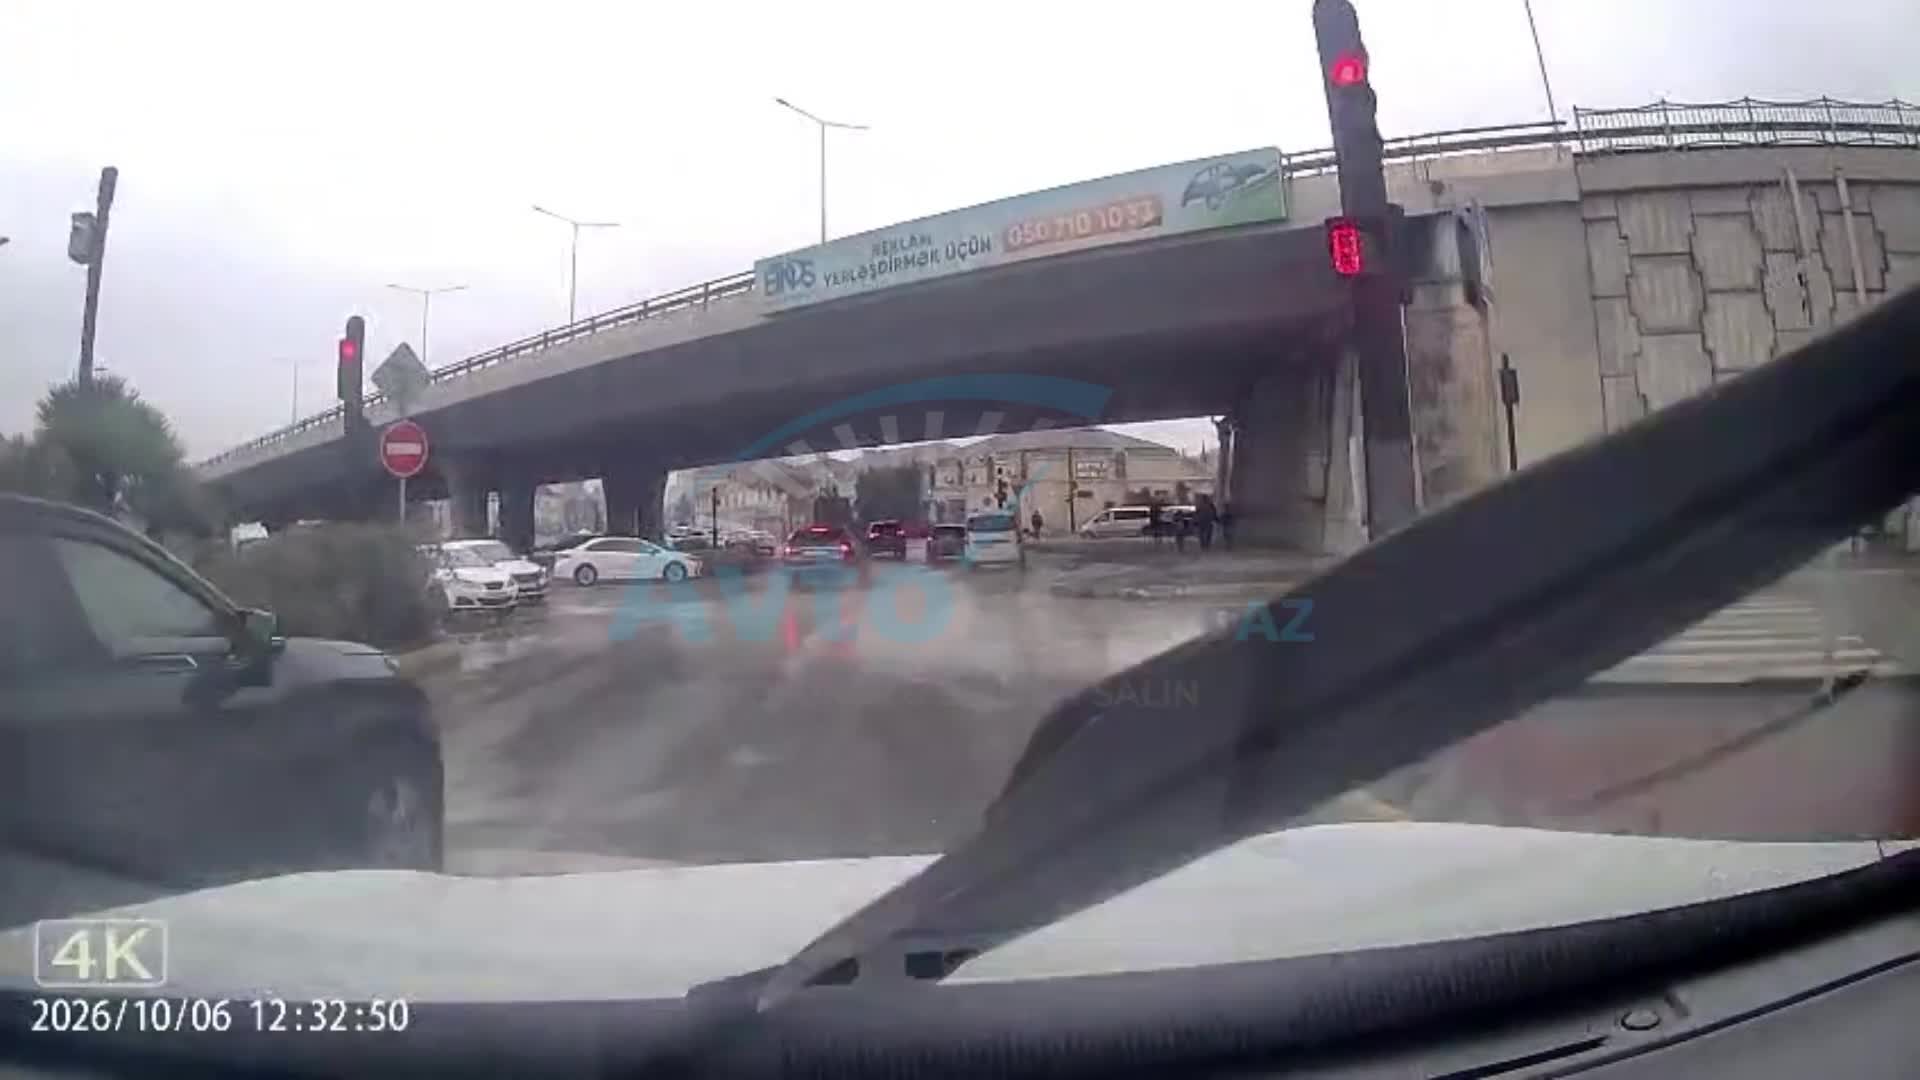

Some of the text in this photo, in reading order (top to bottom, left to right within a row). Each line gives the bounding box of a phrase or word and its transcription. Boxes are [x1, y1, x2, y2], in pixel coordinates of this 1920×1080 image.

[1008, 222, 1049, 246] 050
[1055, 212, 1092, 240] 710
[1096, 205, 1123, 229] 10
[945, 235, 991, 261] ÜÇÜN
